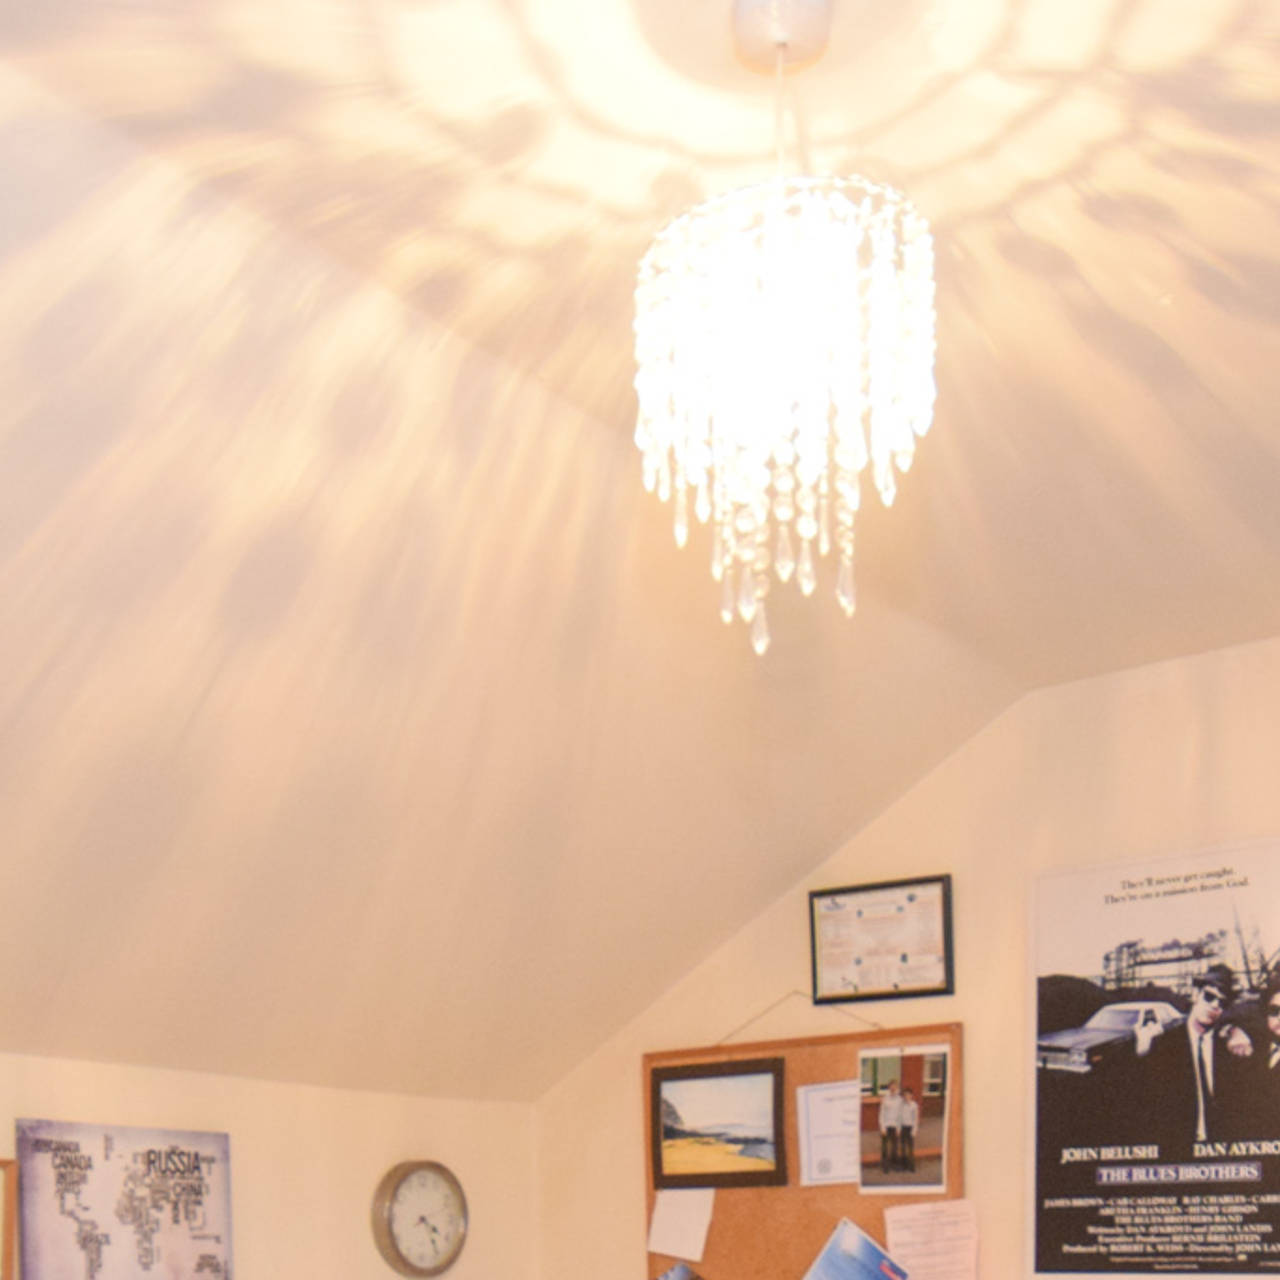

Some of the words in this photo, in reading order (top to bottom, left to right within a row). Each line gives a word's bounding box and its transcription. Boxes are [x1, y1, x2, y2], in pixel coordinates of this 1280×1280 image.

[1060, 1147, 1099, 1164] JOHN
[1100, 1145, 1160, 1161] BELUSHI
[1192, 1142, 1228, 1157] DAN
[147, 1150, 202, 1176] RUSSIA
[1100, 1168, 1129, 1183] THE
[1131, 1166, 1177, 1182] BLUES
[1179, 1164, 1260, 1181] BROTHERS
